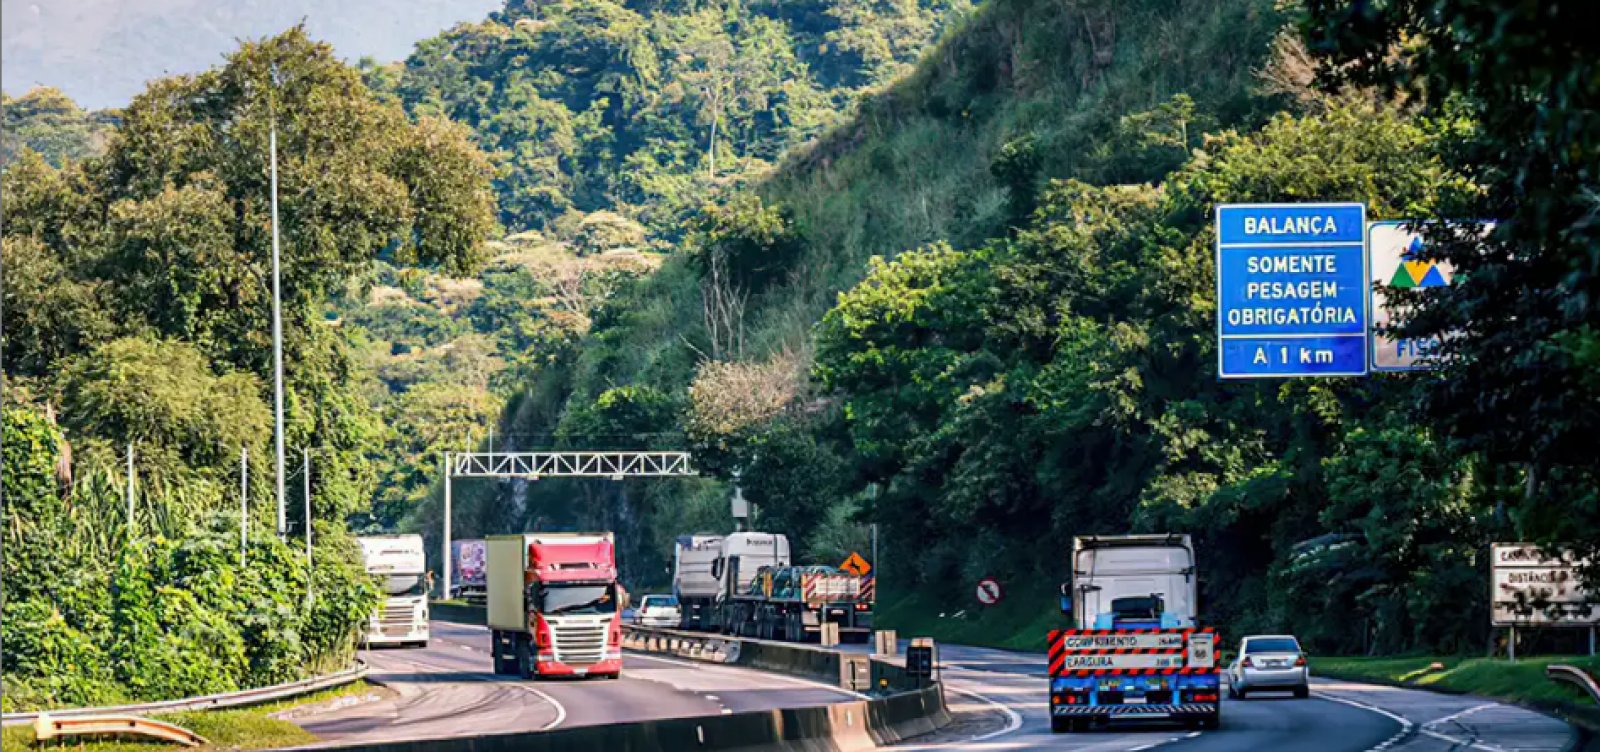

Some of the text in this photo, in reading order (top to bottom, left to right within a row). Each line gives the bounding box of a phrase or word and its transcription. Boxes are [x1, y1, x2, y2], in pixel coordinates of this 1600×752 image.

[1244, 216, 1337, 235] BALANÇA
[1247, 255, 1337, 273] SOMENTE
[1247, 281, 1337, 299] PESAGEM
[1228, 302, 1357, 326] OBRIGATÓRIA
[1253, 346, 1334, 364] A 1 km
